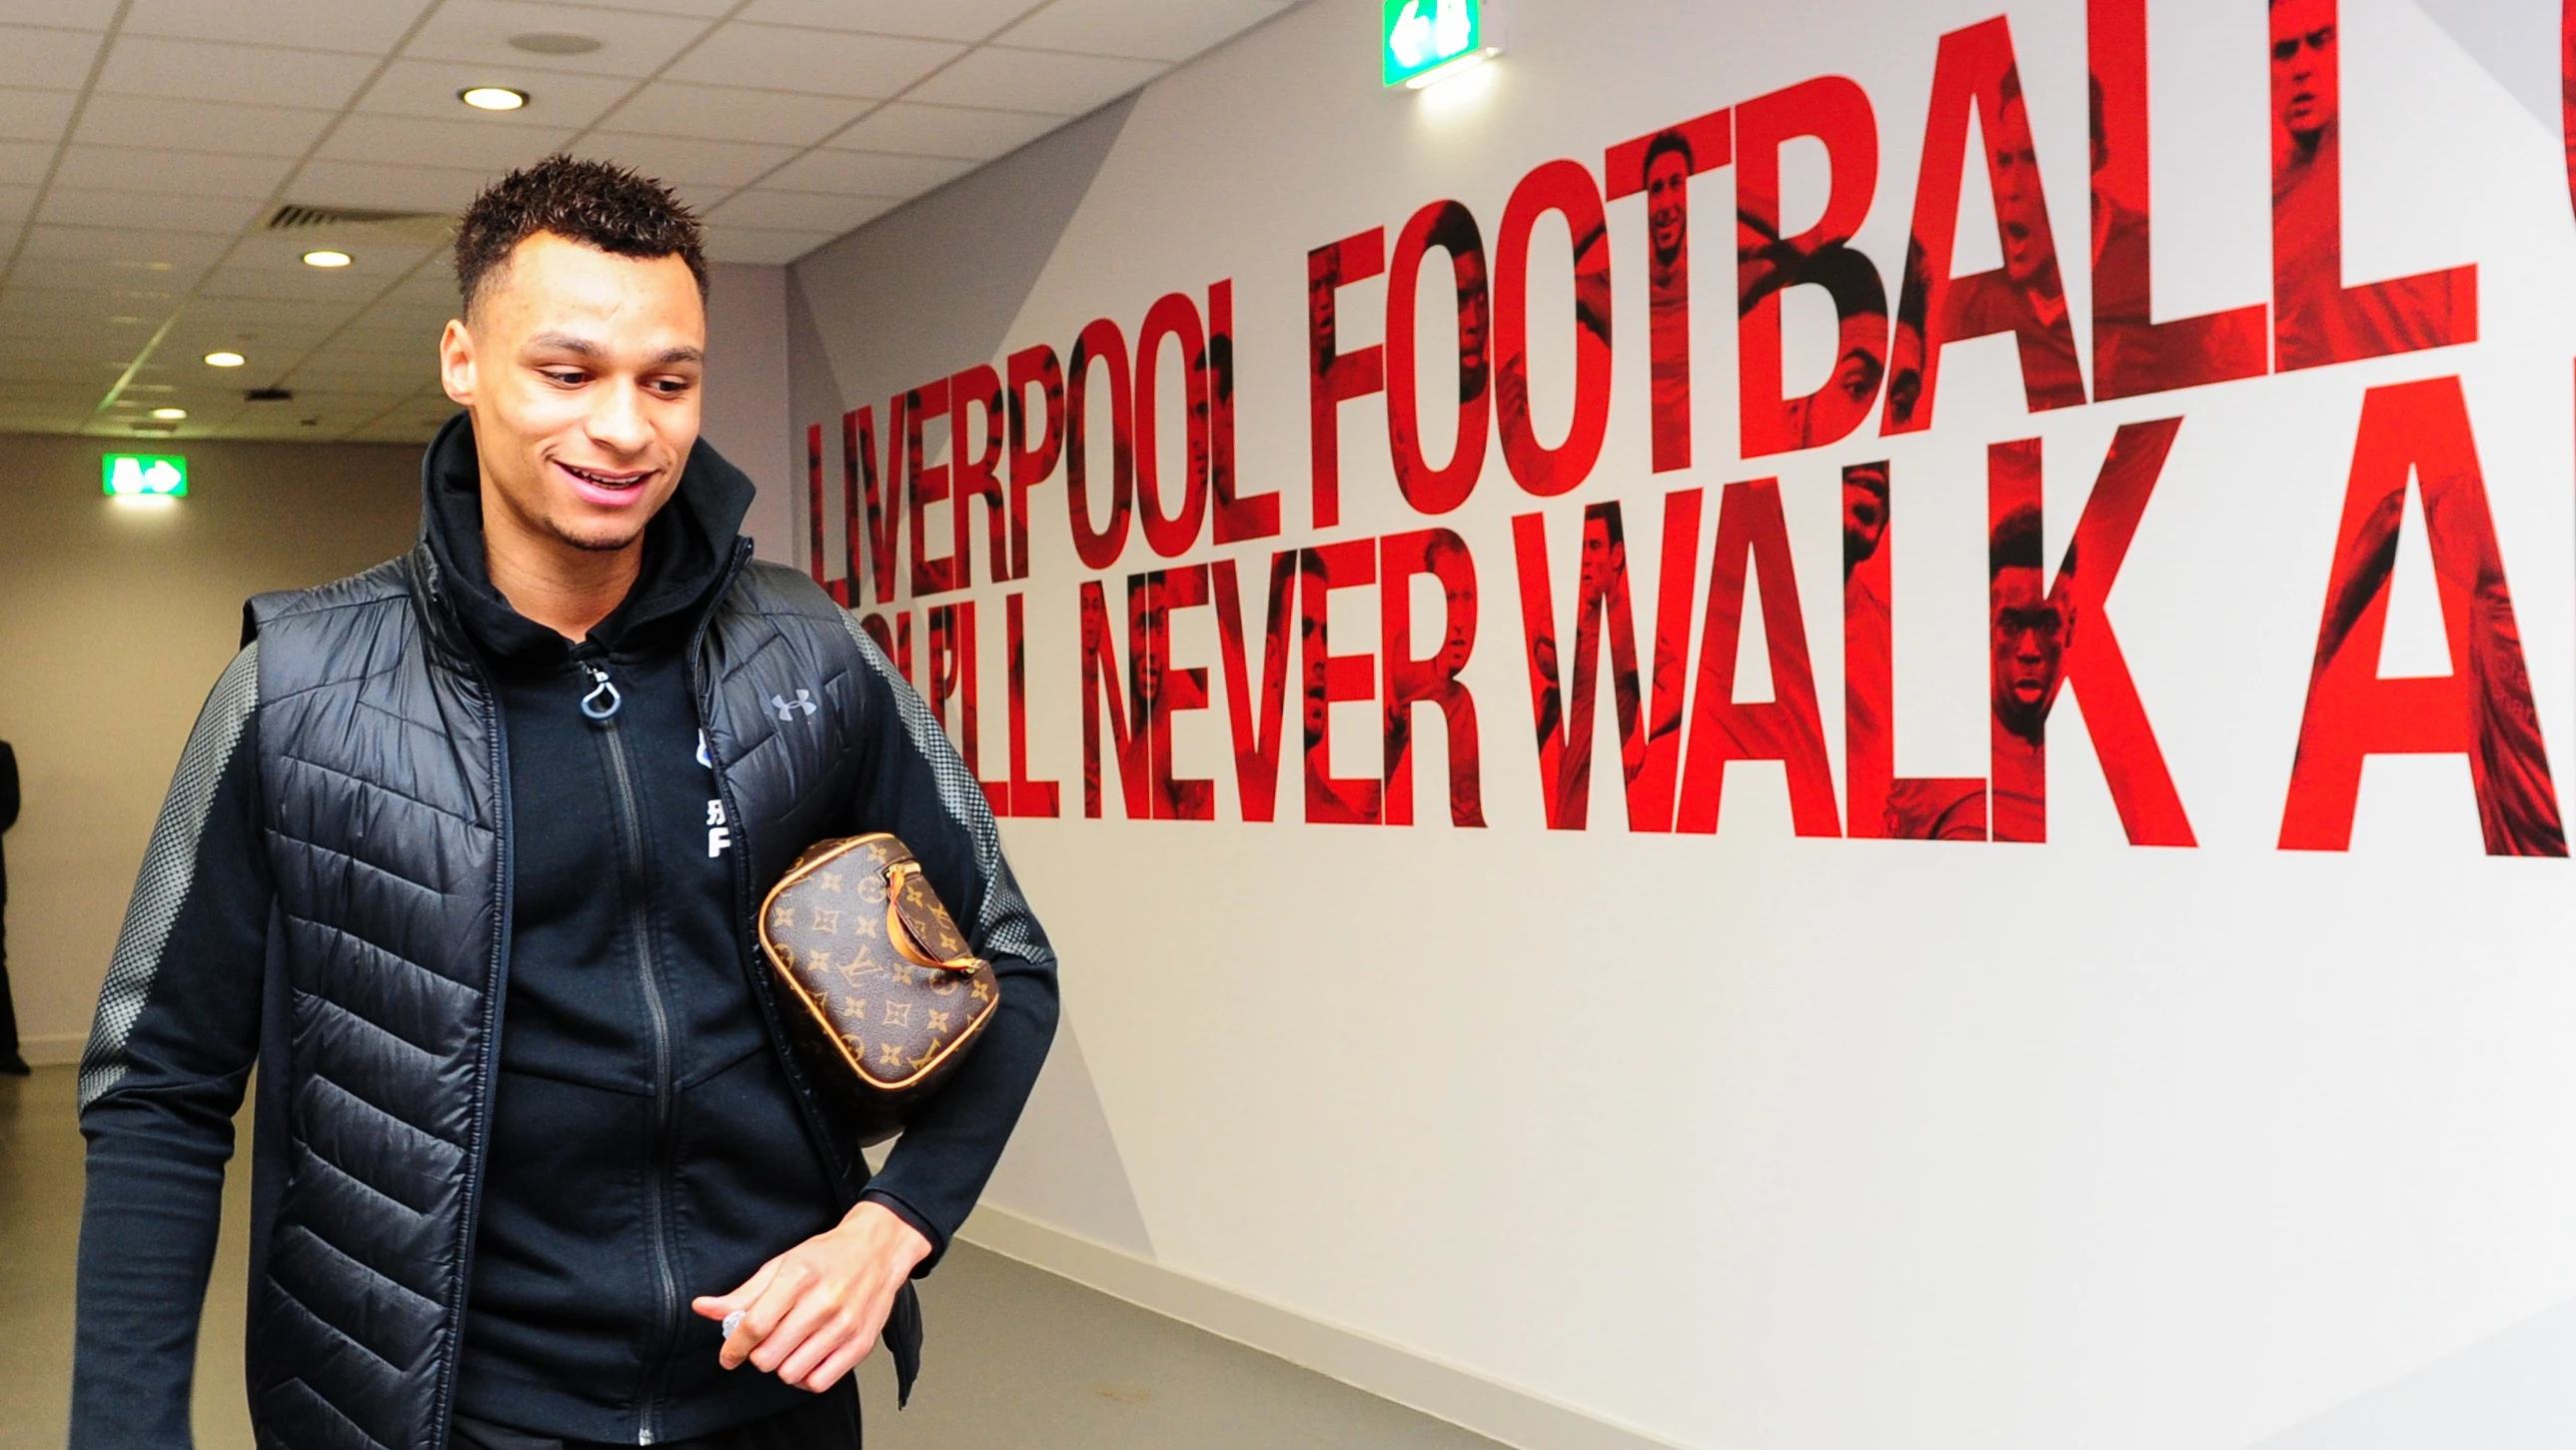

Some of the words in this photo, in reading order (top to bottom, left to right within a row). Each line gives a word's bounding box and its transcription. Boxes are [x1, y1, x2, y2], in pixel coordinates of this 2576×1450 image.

[807, 278, 1281, 609] LIVERPOOL
[1307, 0, 2478, 530] FOOTBALL
[859, 592, 1060, 818] 'LL
[1079, 528, 1489, 828] NEVER
[1511, 415, 2199, 848] WALK
